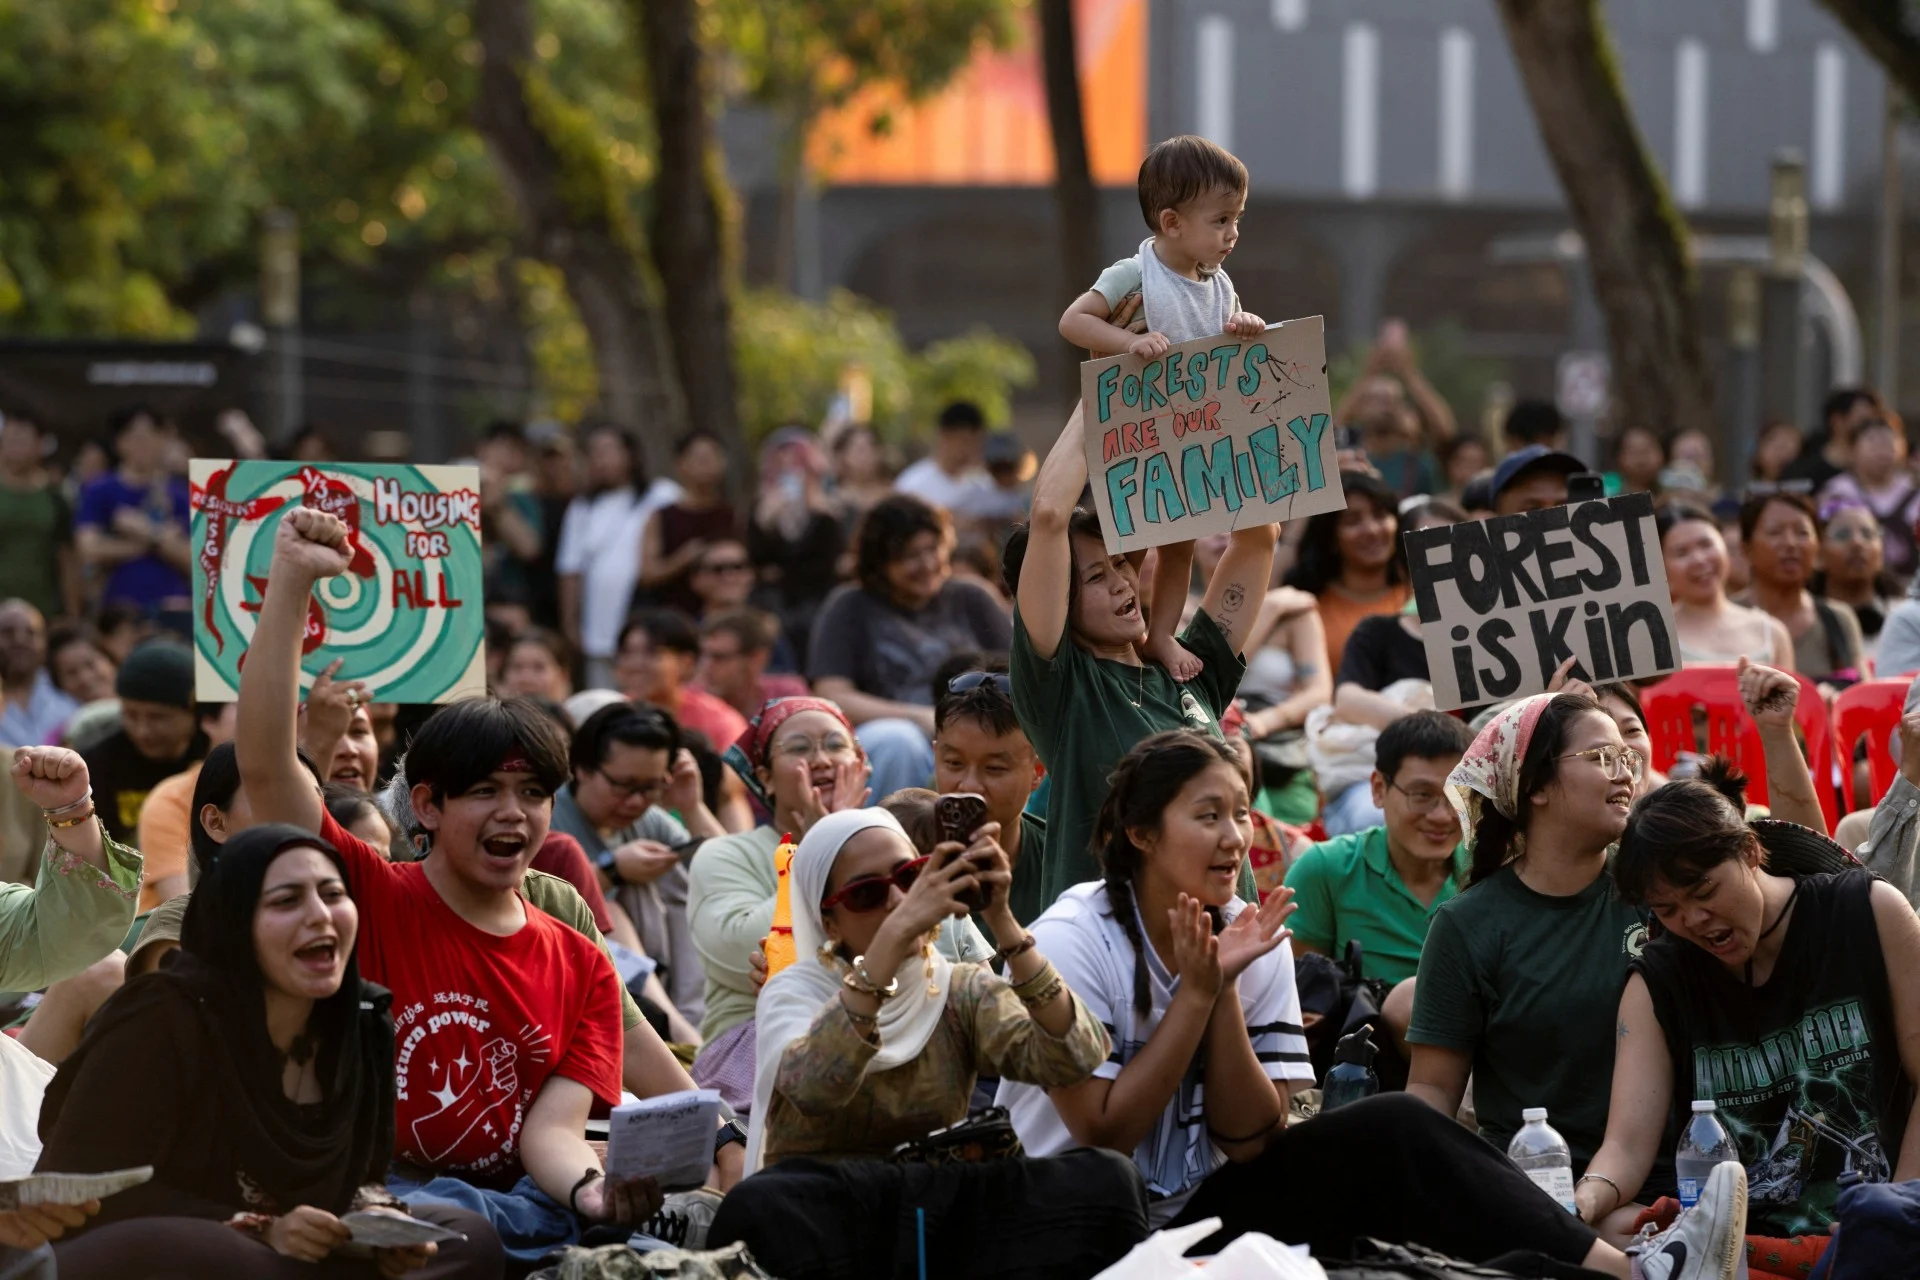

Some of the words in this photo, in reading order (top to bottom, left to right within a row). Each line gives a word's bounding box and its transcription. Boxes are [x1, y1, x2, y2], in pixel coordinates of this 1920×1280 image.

[1098, 344, 1268, 423] FORESTS
[1104, 418, 1159, 463] ARE
[1173, 402, 1221, 440] OUR
[1106, 413, 1330, 537] FAMILY
[406, 532, 450, 559] FOR
[1403, 491, 1655, 624] FOREST
[392, 569, 462, 610] ALL
[433, 991, 489, 1012] 还权于民
[396, 1025, 426, 1101] return
[427, 1010, 491, 1034] power
[1694, 1032, 1798, 1101] DAYTONA
[1796, 1001, 1871, 1071] EACH
[1822, 1050, 1870, 1071] FLORIDA
